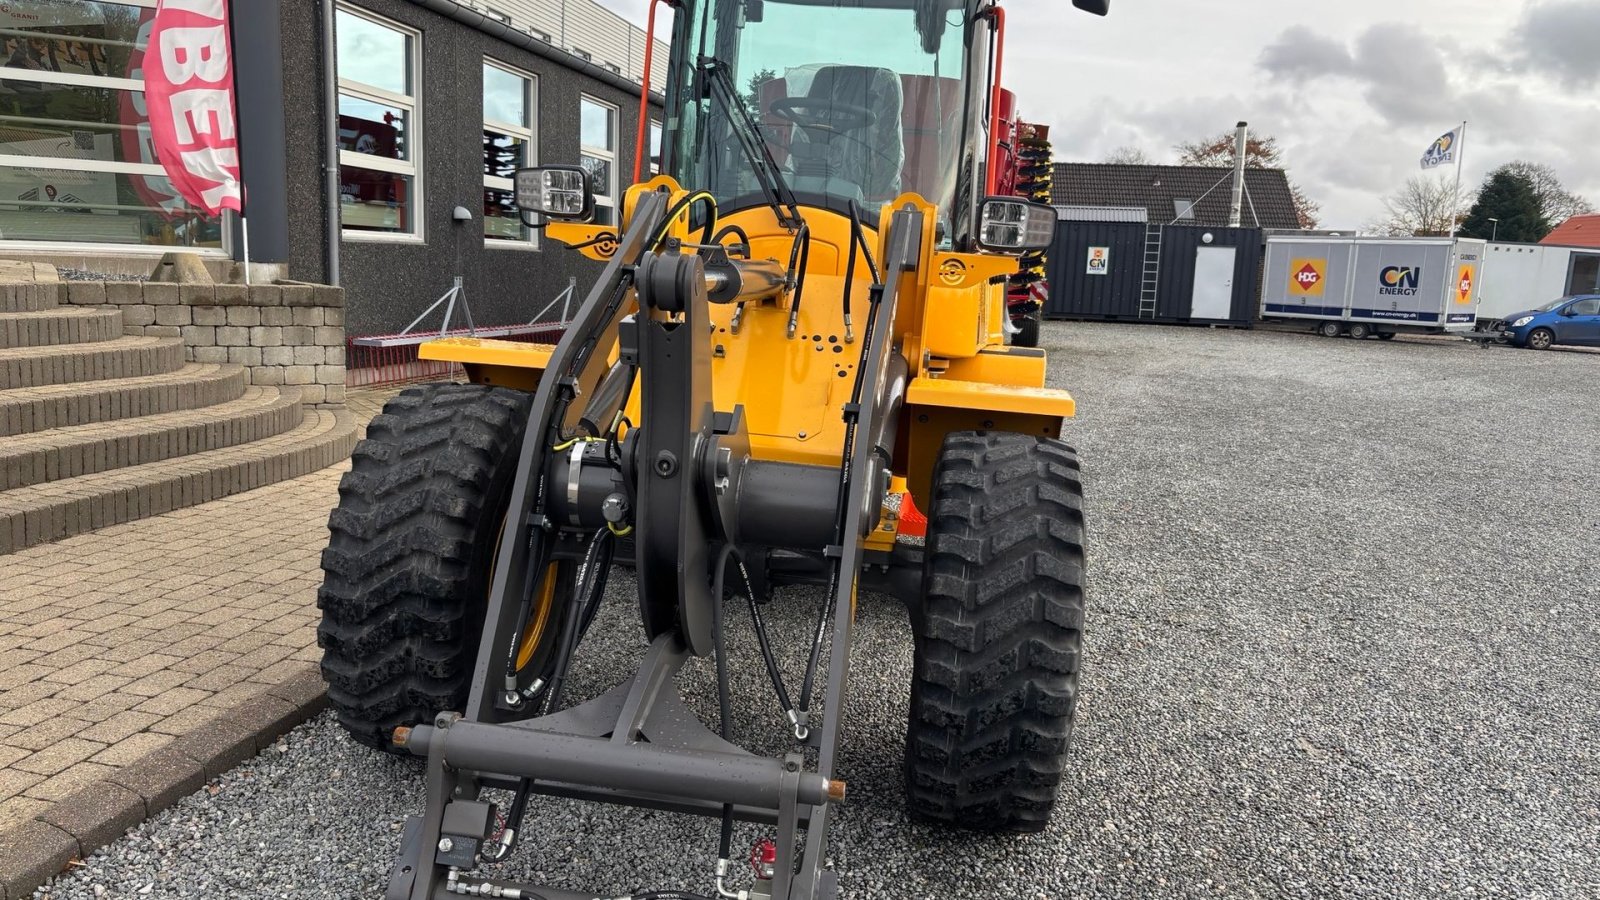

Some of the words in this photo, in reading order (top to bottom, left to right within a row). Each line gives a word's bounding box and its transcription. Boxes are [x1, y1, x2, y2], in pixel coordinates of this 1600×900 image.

[10, 12, 39, 20] GRANIT
[1298, 272, 1317, 282] HDG
[1379, 265, 1420, 288] CN
[1379, 287, 1417, 296] ENERGY
[578, 562, 588, 586] VOLVO
